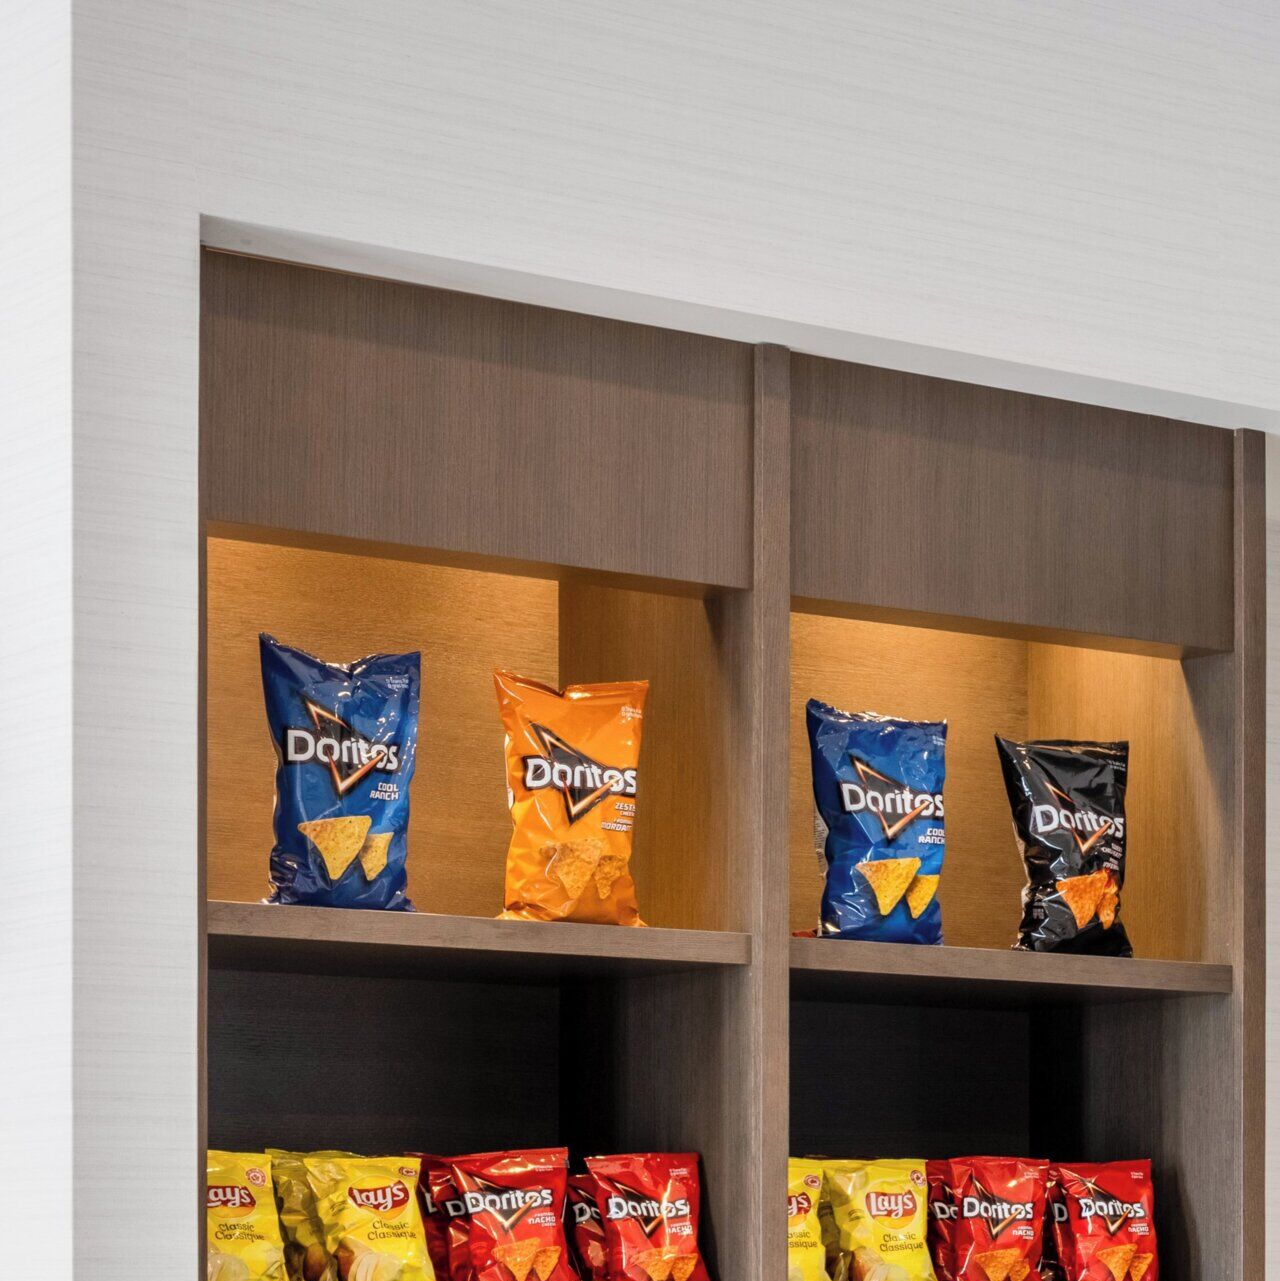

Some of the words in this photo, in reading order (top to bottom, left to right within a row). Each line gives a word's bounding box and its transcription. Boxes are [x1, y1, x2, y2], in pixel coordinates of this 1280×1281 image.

[287, 729, 399, 771] Doritos
[525, 758, 637, 793] Doritos
[370, 791, 400, 800] RANCH
[378, 782, 399, 791] COOL
[842, 783, 945, 817] Doritos
[1034, 804, 1125, 838] Doritos
[351, 1182, 406, 1212] Lay's
[464, 1189, 553, 1215] Doritos
[788, 1193, 809, 1218] y's
[870, 1192, 914, 1219] Lay's
[606, 1198, 689, 1221] Doritos
[963, 1197, 1034, 1219] Doritos
[1081, 1198, 1145, 1218] Doritos
[218, 1222, 256, 1232] Classic
[372, 1219, 410, 1231] Classic
[788, 1231, 811, 1240] assic
[214, 1230, 265, 1242] Classique
[367, 1230, 417, 1242] Classique
[788, 1240, 818, 1249] ssique
[879, 1241, 924, 1252] Classique
